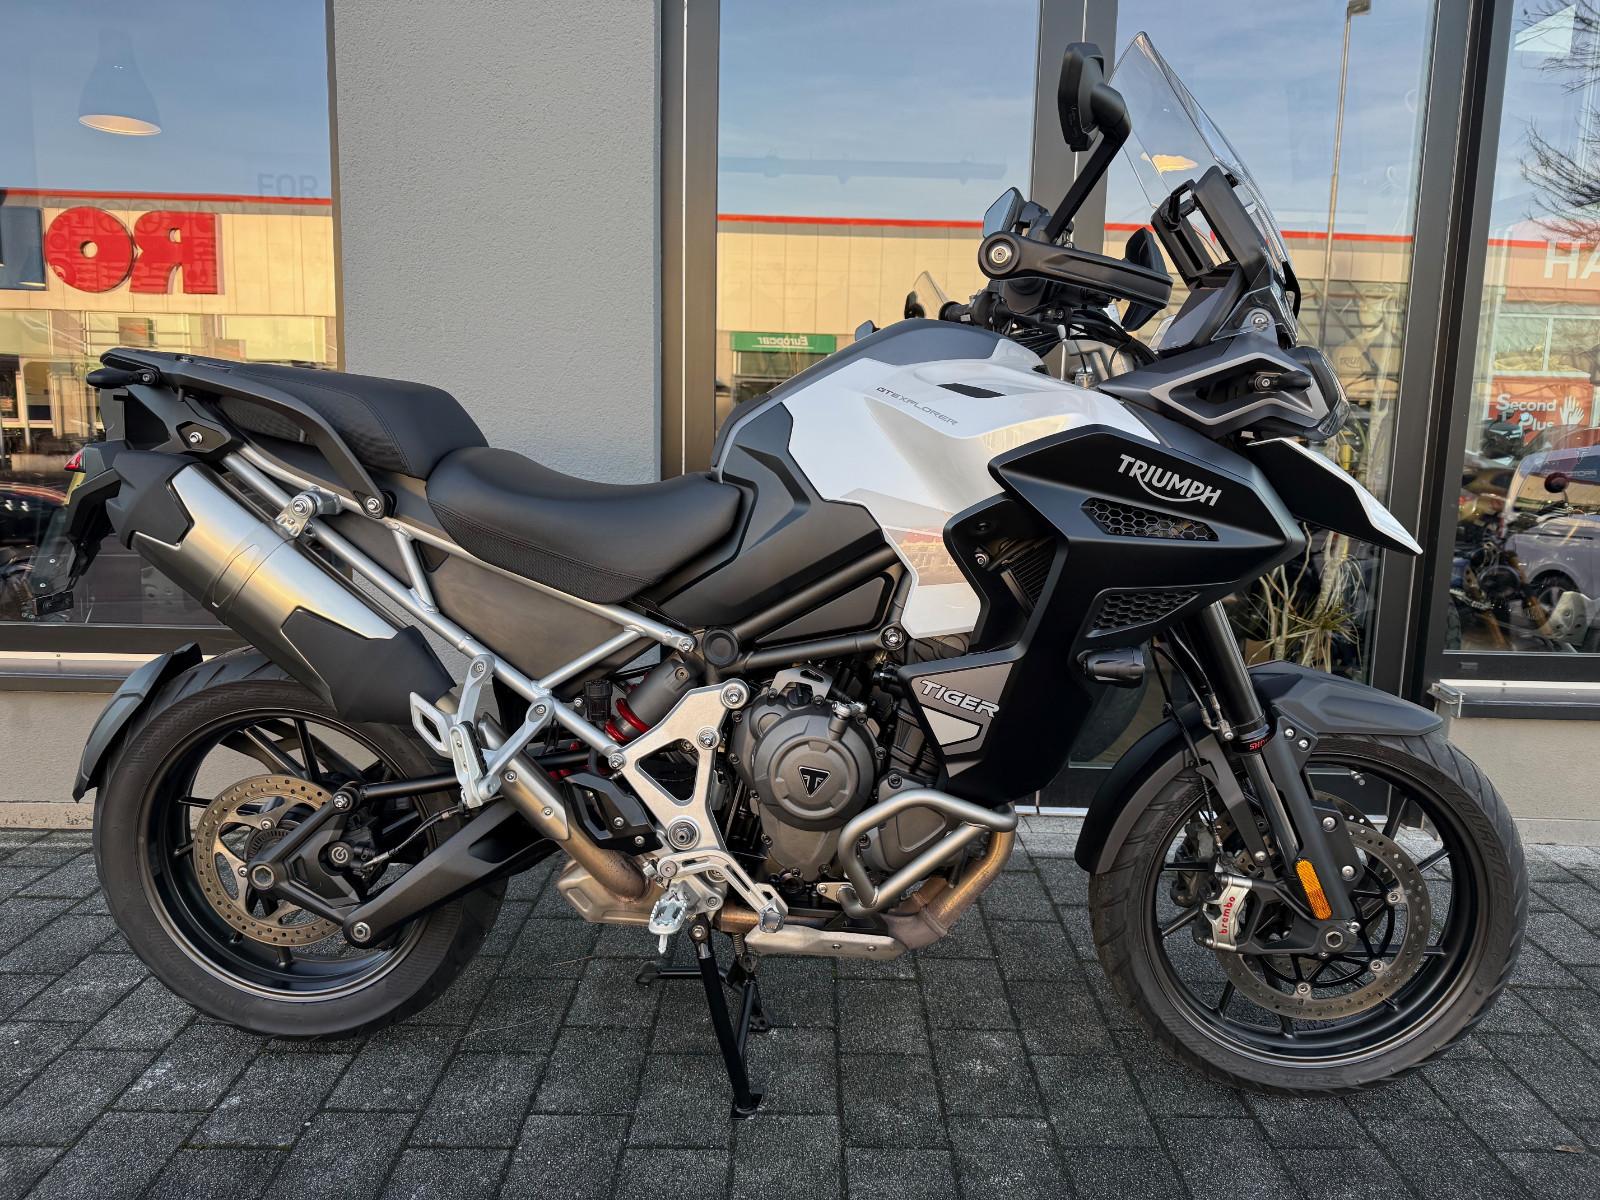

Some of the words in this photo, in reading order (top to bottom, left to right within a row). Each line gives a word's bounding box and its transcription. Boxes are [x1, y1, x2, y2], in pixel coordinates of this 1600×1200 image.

[256, 172, 319, 200] FOR
[1495, 393, 1557, 412] Second
[1118, 453, 1223, 507] TRIUMPH
[920, 679, 1000, 719] TIGER
[1218, 896, 1236, 935] brembo
